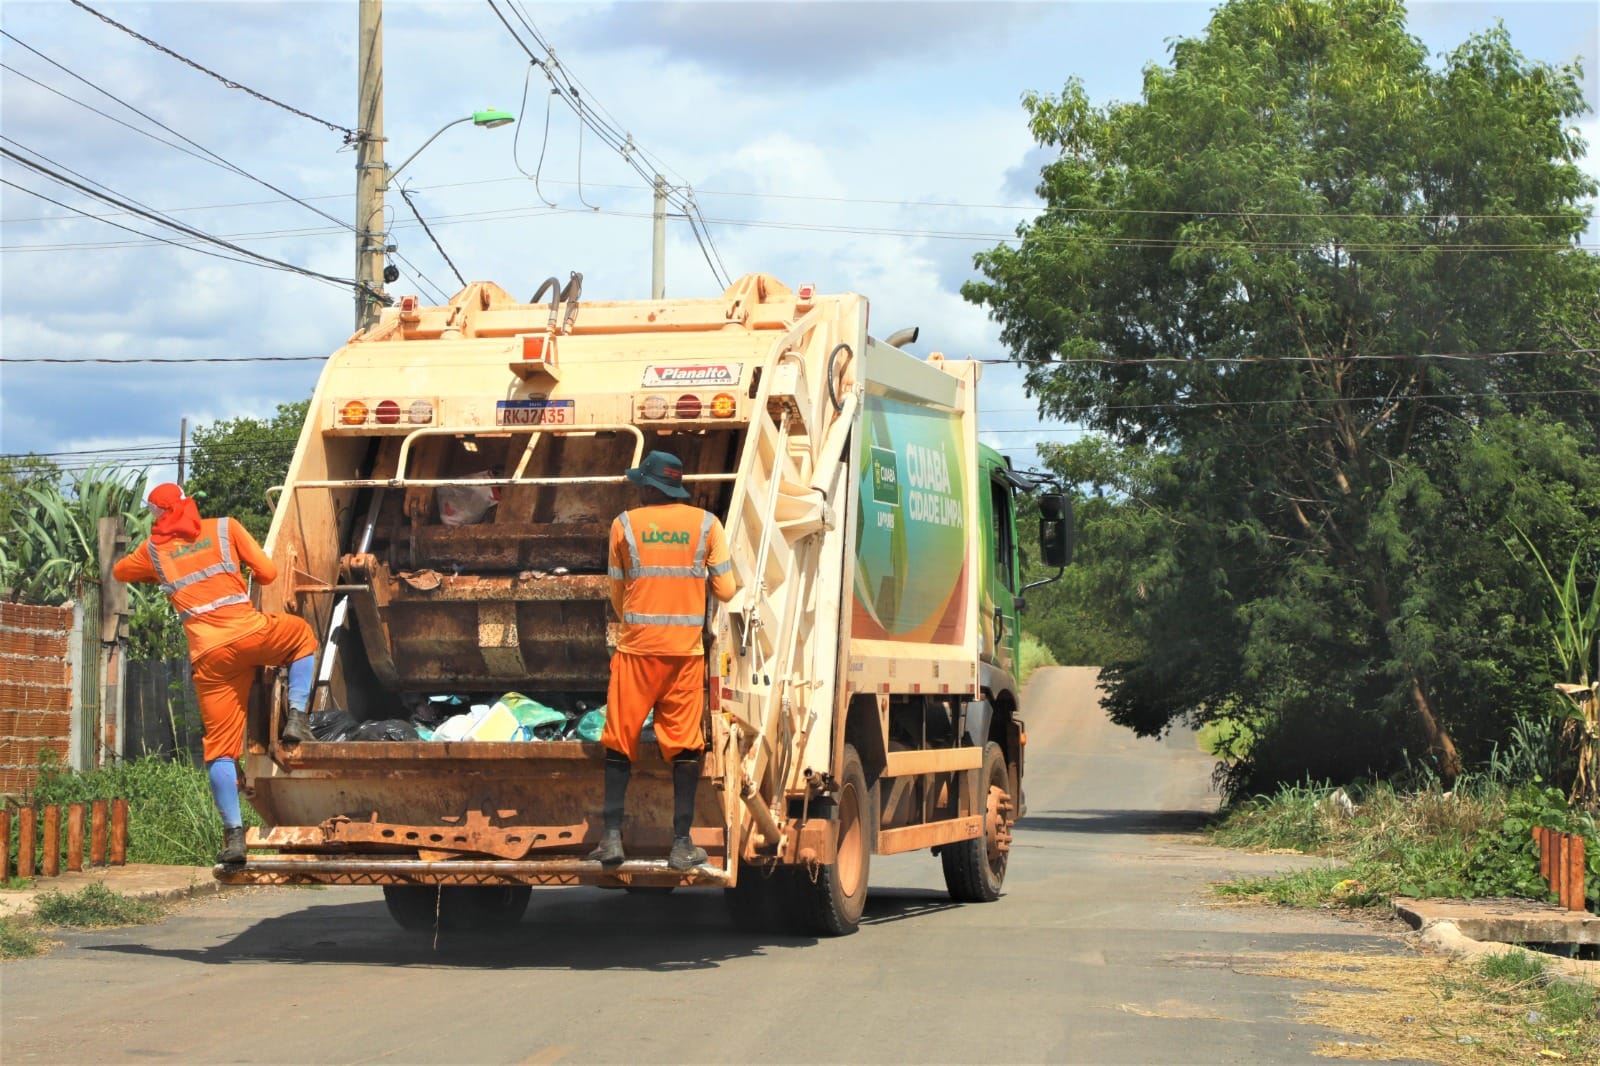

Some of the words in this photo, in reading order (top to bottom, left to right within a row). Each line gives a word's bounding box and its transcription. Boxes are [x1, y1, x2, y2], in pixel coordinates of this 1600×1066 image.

[660, 367, 728, 380] Planalto
[503, 409, 565, 424] RKJ7A35
[906, 442, 951, 495] CUIABÁ
[909, 490, 939, 524] CIDADE
[941, 496, 963, 529] LIMPA
[642, 530, 690, 544] LOCAR
